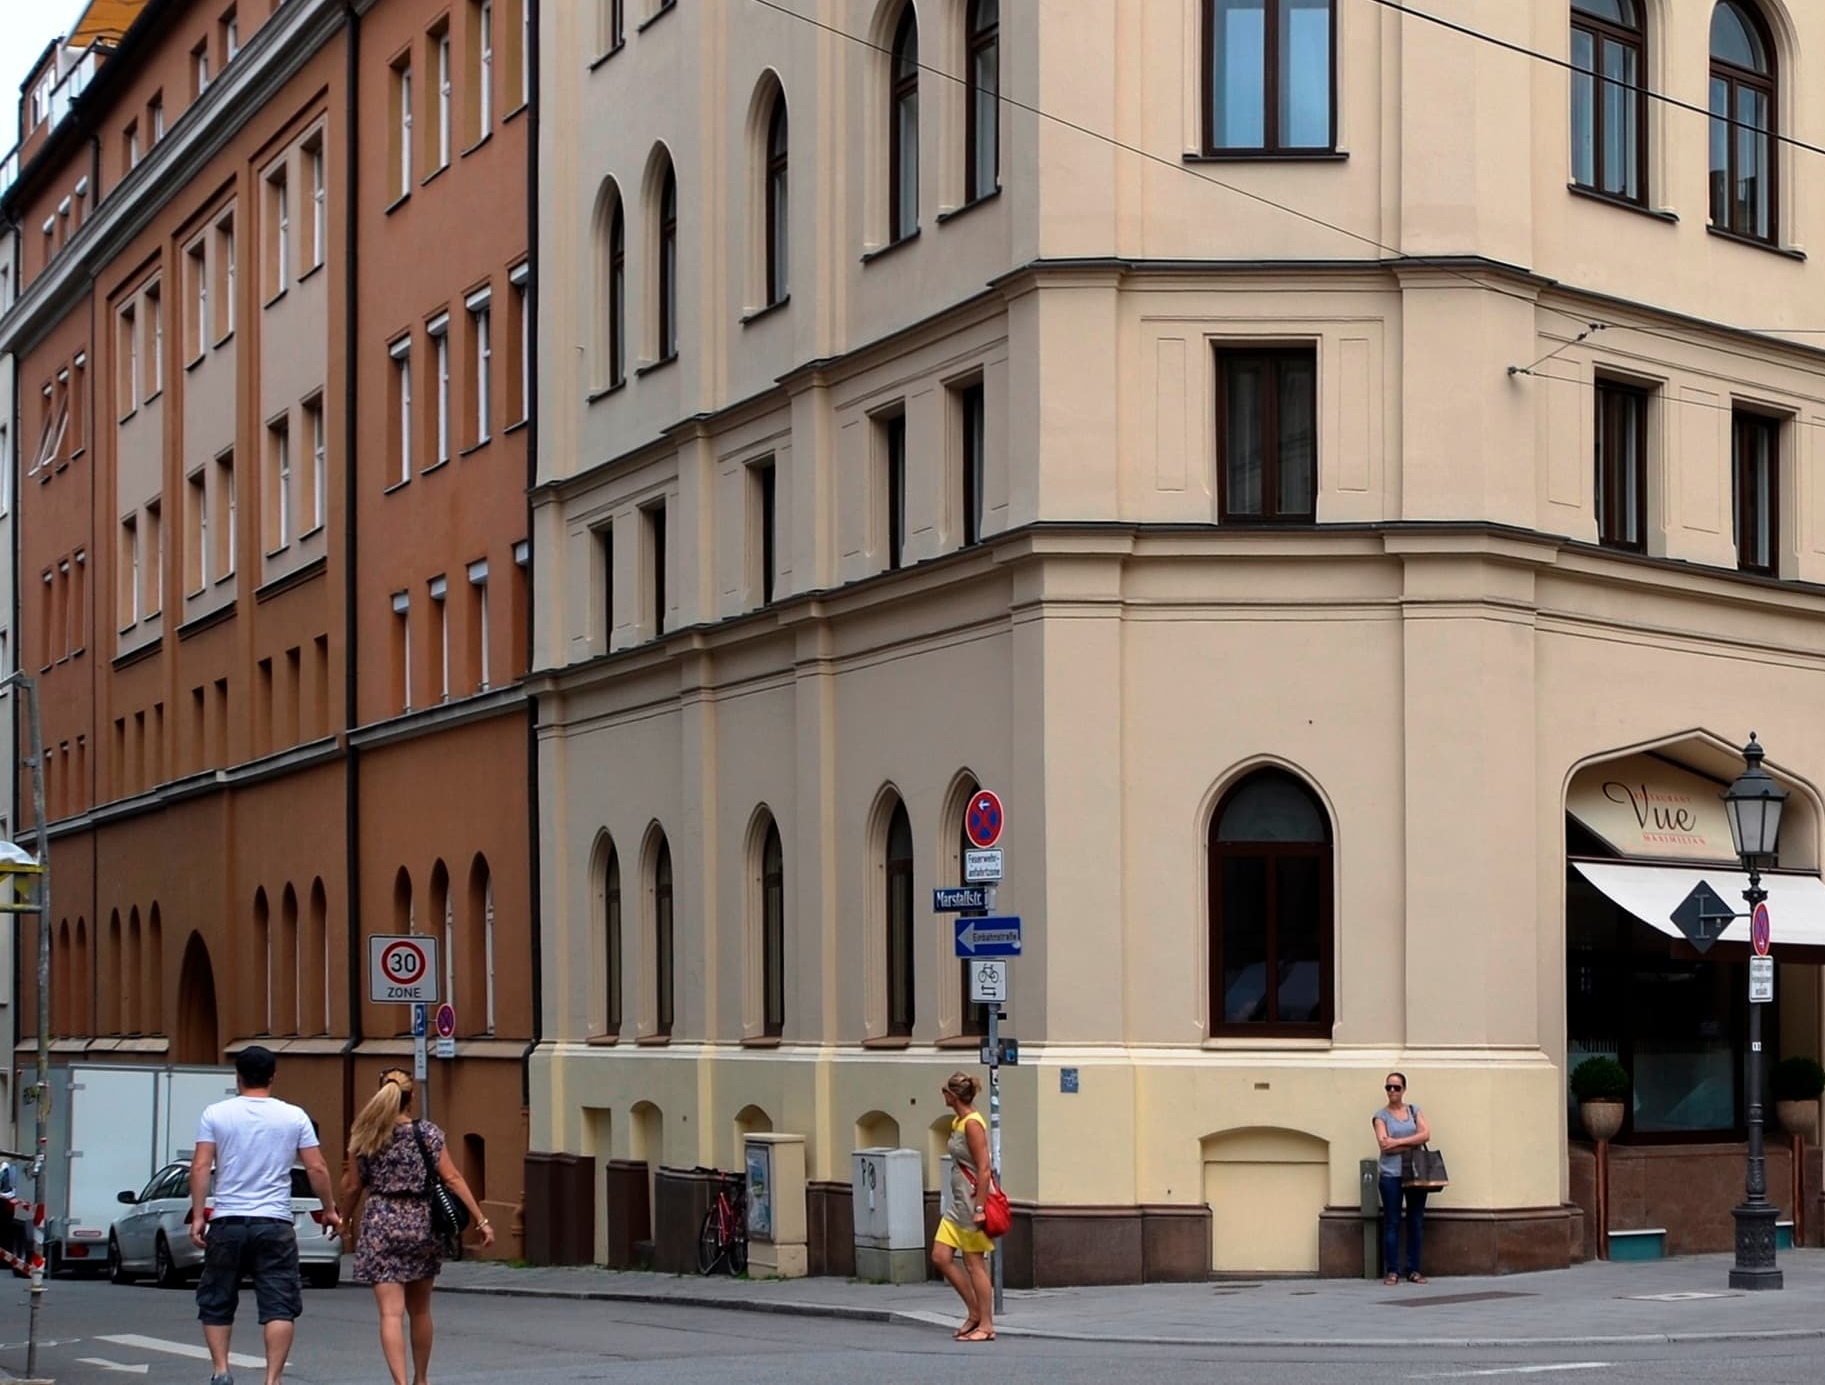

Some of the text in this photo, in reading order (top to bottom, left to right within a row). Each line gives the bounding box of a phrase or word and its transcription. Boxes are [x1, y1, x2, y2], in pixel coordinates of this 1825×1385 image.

[1602, 781, 1697, 832] Vue
[936, 890, 983, 908] Marstallstr.
[390, 953, 416, 973] 30
[387, 987, 422, 998] ZONE
